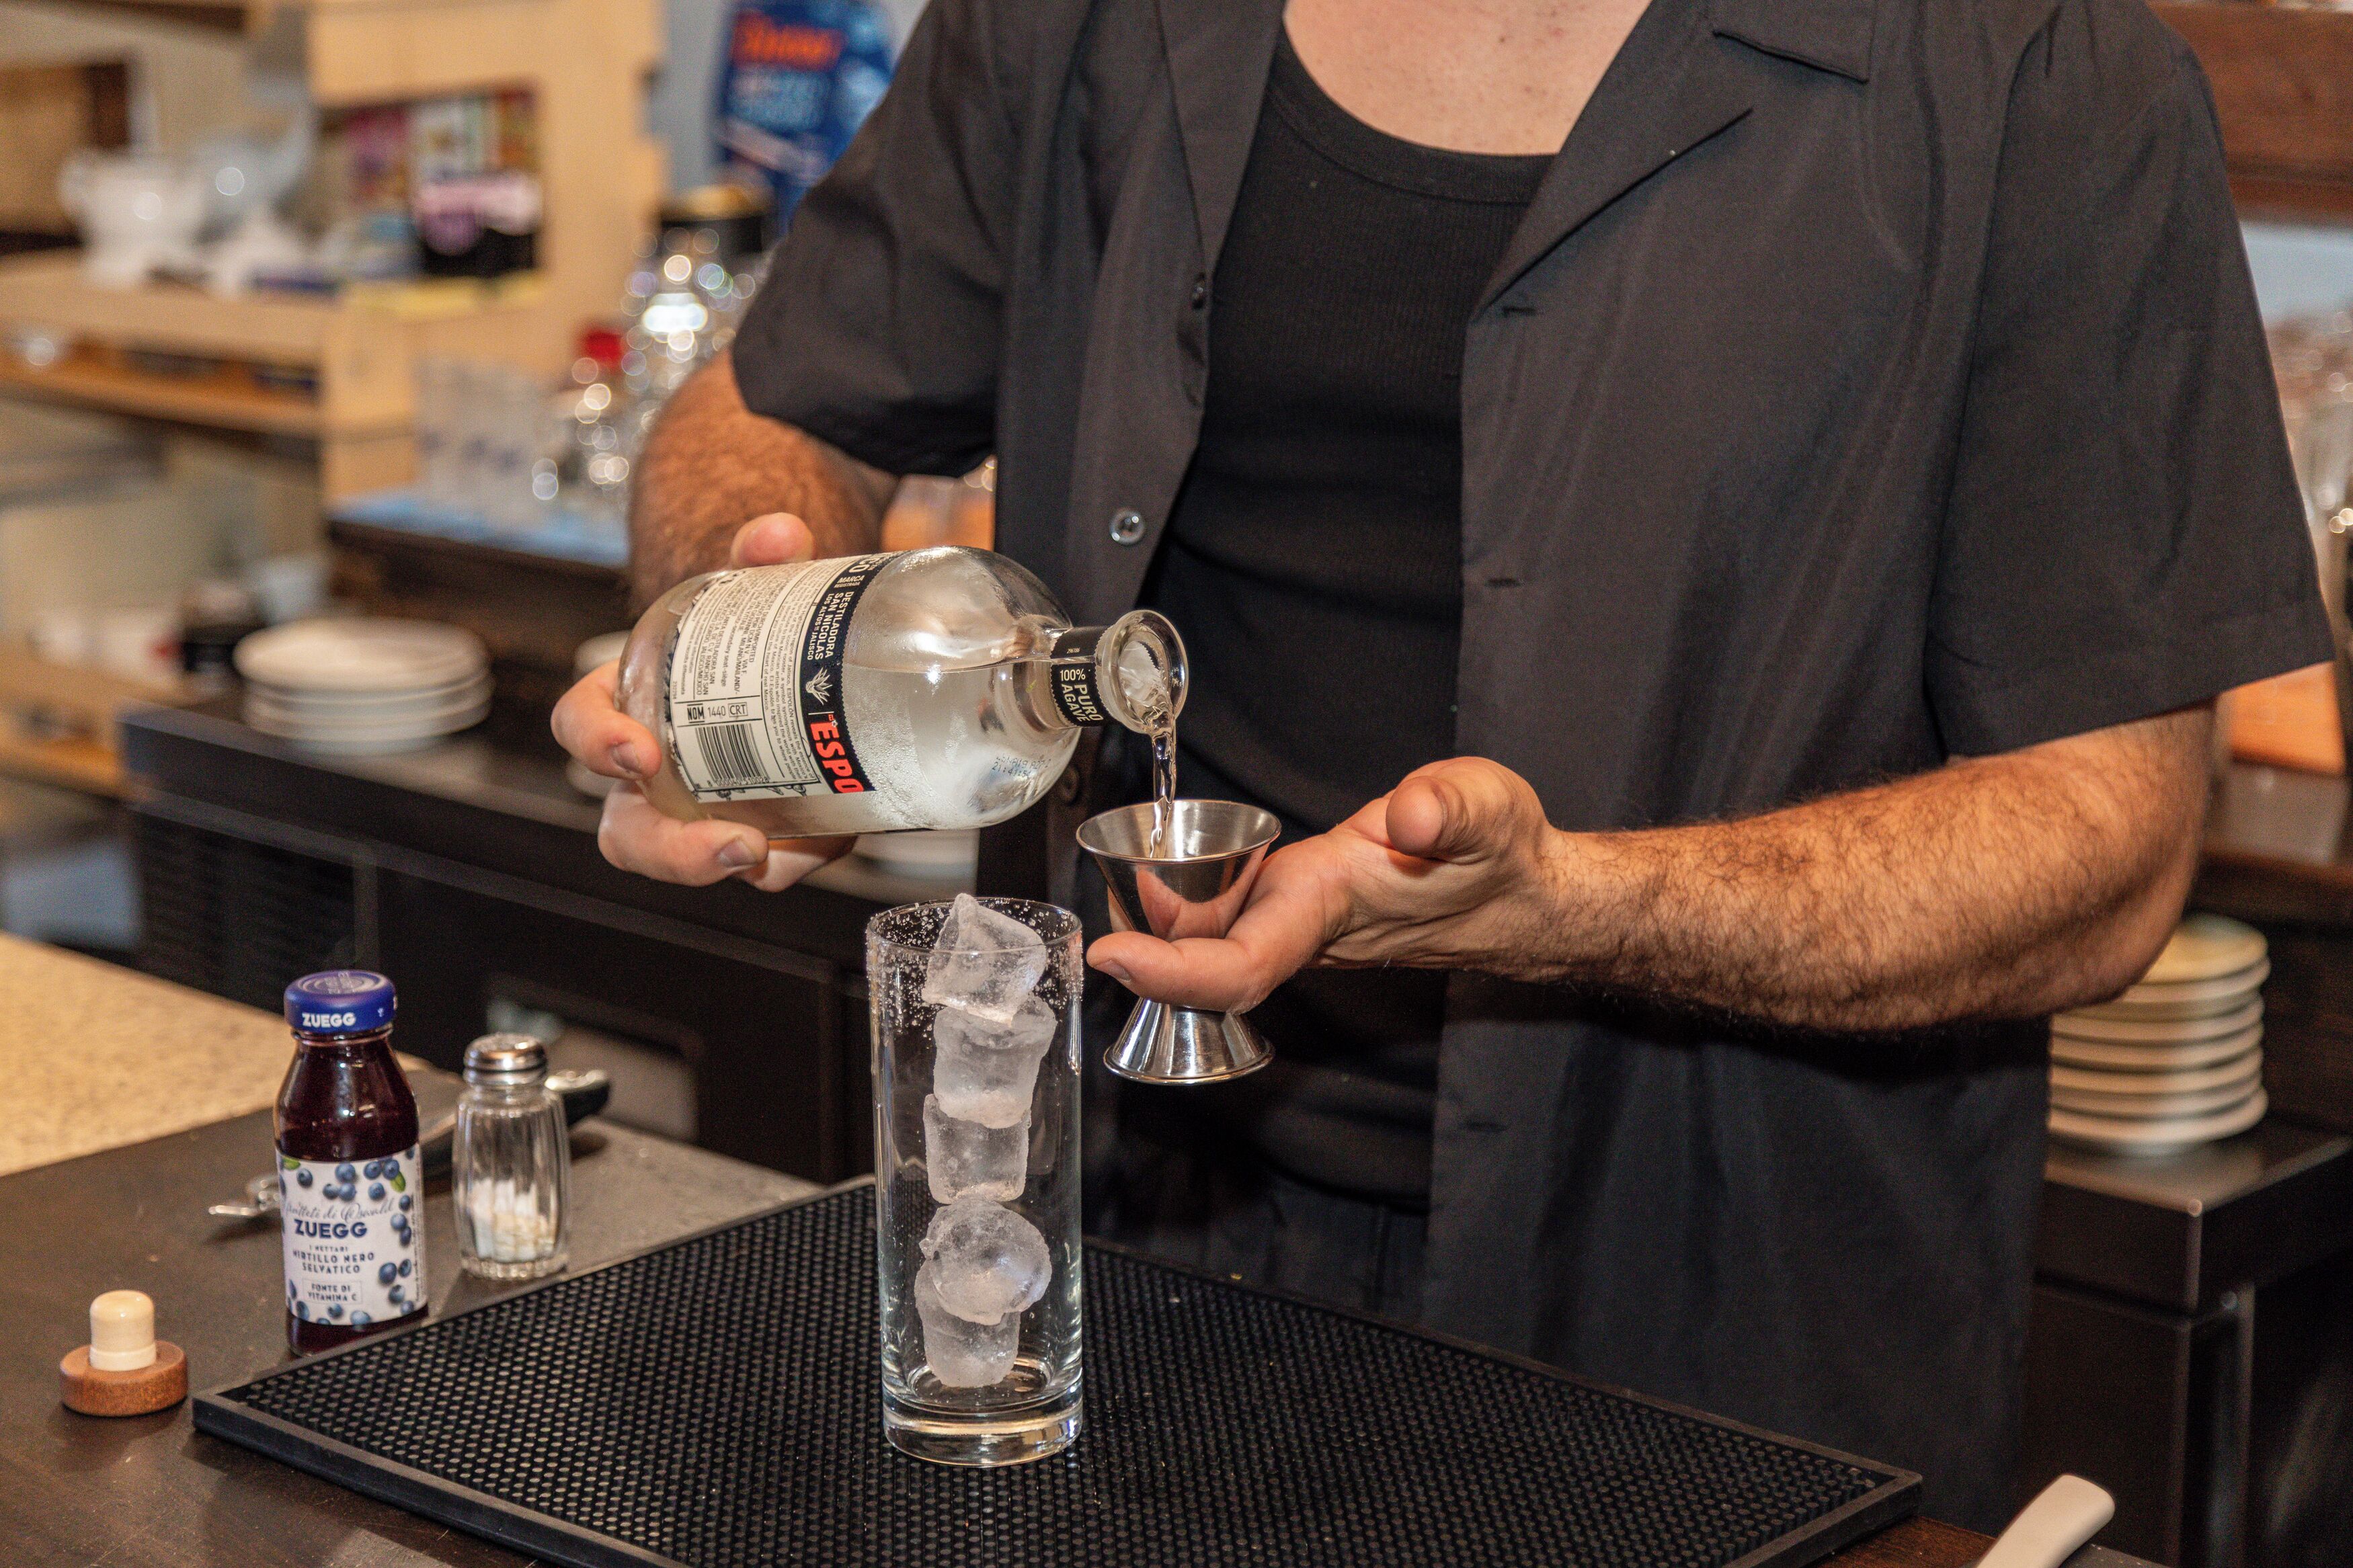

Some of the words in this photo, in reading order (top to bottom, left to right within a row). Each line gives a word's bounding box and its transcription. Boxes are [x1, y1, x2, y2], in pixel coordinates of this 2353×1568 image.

[837, 575, 865, 583] MARCA
[824, 593, 834, 604] LOS
[828, 592, 844, 611] SAN
[785, 612, 794, 628] tribute
[815, 606, 827, 626] ALTOS
[825, 591, 854, 658] DESTILADORA
[747, 630, 755, 643] DCM
[749, 612, 768, 663] DURCH/IMPORTED
[807, 632, 817, 660] JALISCO
[815, 614, 834, 659] NICOLAS
[710, 630, 724, 670] DESTILADORA
[696, 646, 707, 695] JALISCO/MEXICO
[703, 655, 712, 681] RANCHO
[1060, 668, 1086, 682] 100%
[793, 611, 805, 636] Highlands
[799, 751, 810, 772] essence
[1061, 684, 1090, 722] AGAVE
[1074, 684, 1104, 720] PURO
[687, 706, 705, 720] NOM
[708, 706, 726, 717] 1440
[729, 704, 745, 715] CRT
[783, 706, 791, 741] synonymous
[795, 757, 807, 779] Mexico's
[783, 739, 791, 754] world
[779, 745, 787, 761] where
[785, 764, 796, 780] people
[794, 768, 802, 778] their
[302, 1012, 356, 1028] ZUEGG
[294, 1219, 368, 1239] ZUEGG
[292, 1250, 337, 1263] MIRTILLO
[344, 1252, 374, 1263] NERO
[302, 1263, 360, 1274] SELVATICO
[308, 1292, 348, 1302] VITAMINA
[311, 1283, 337, 1292] FONTE
[341, 1284, 351, 1292] DI
